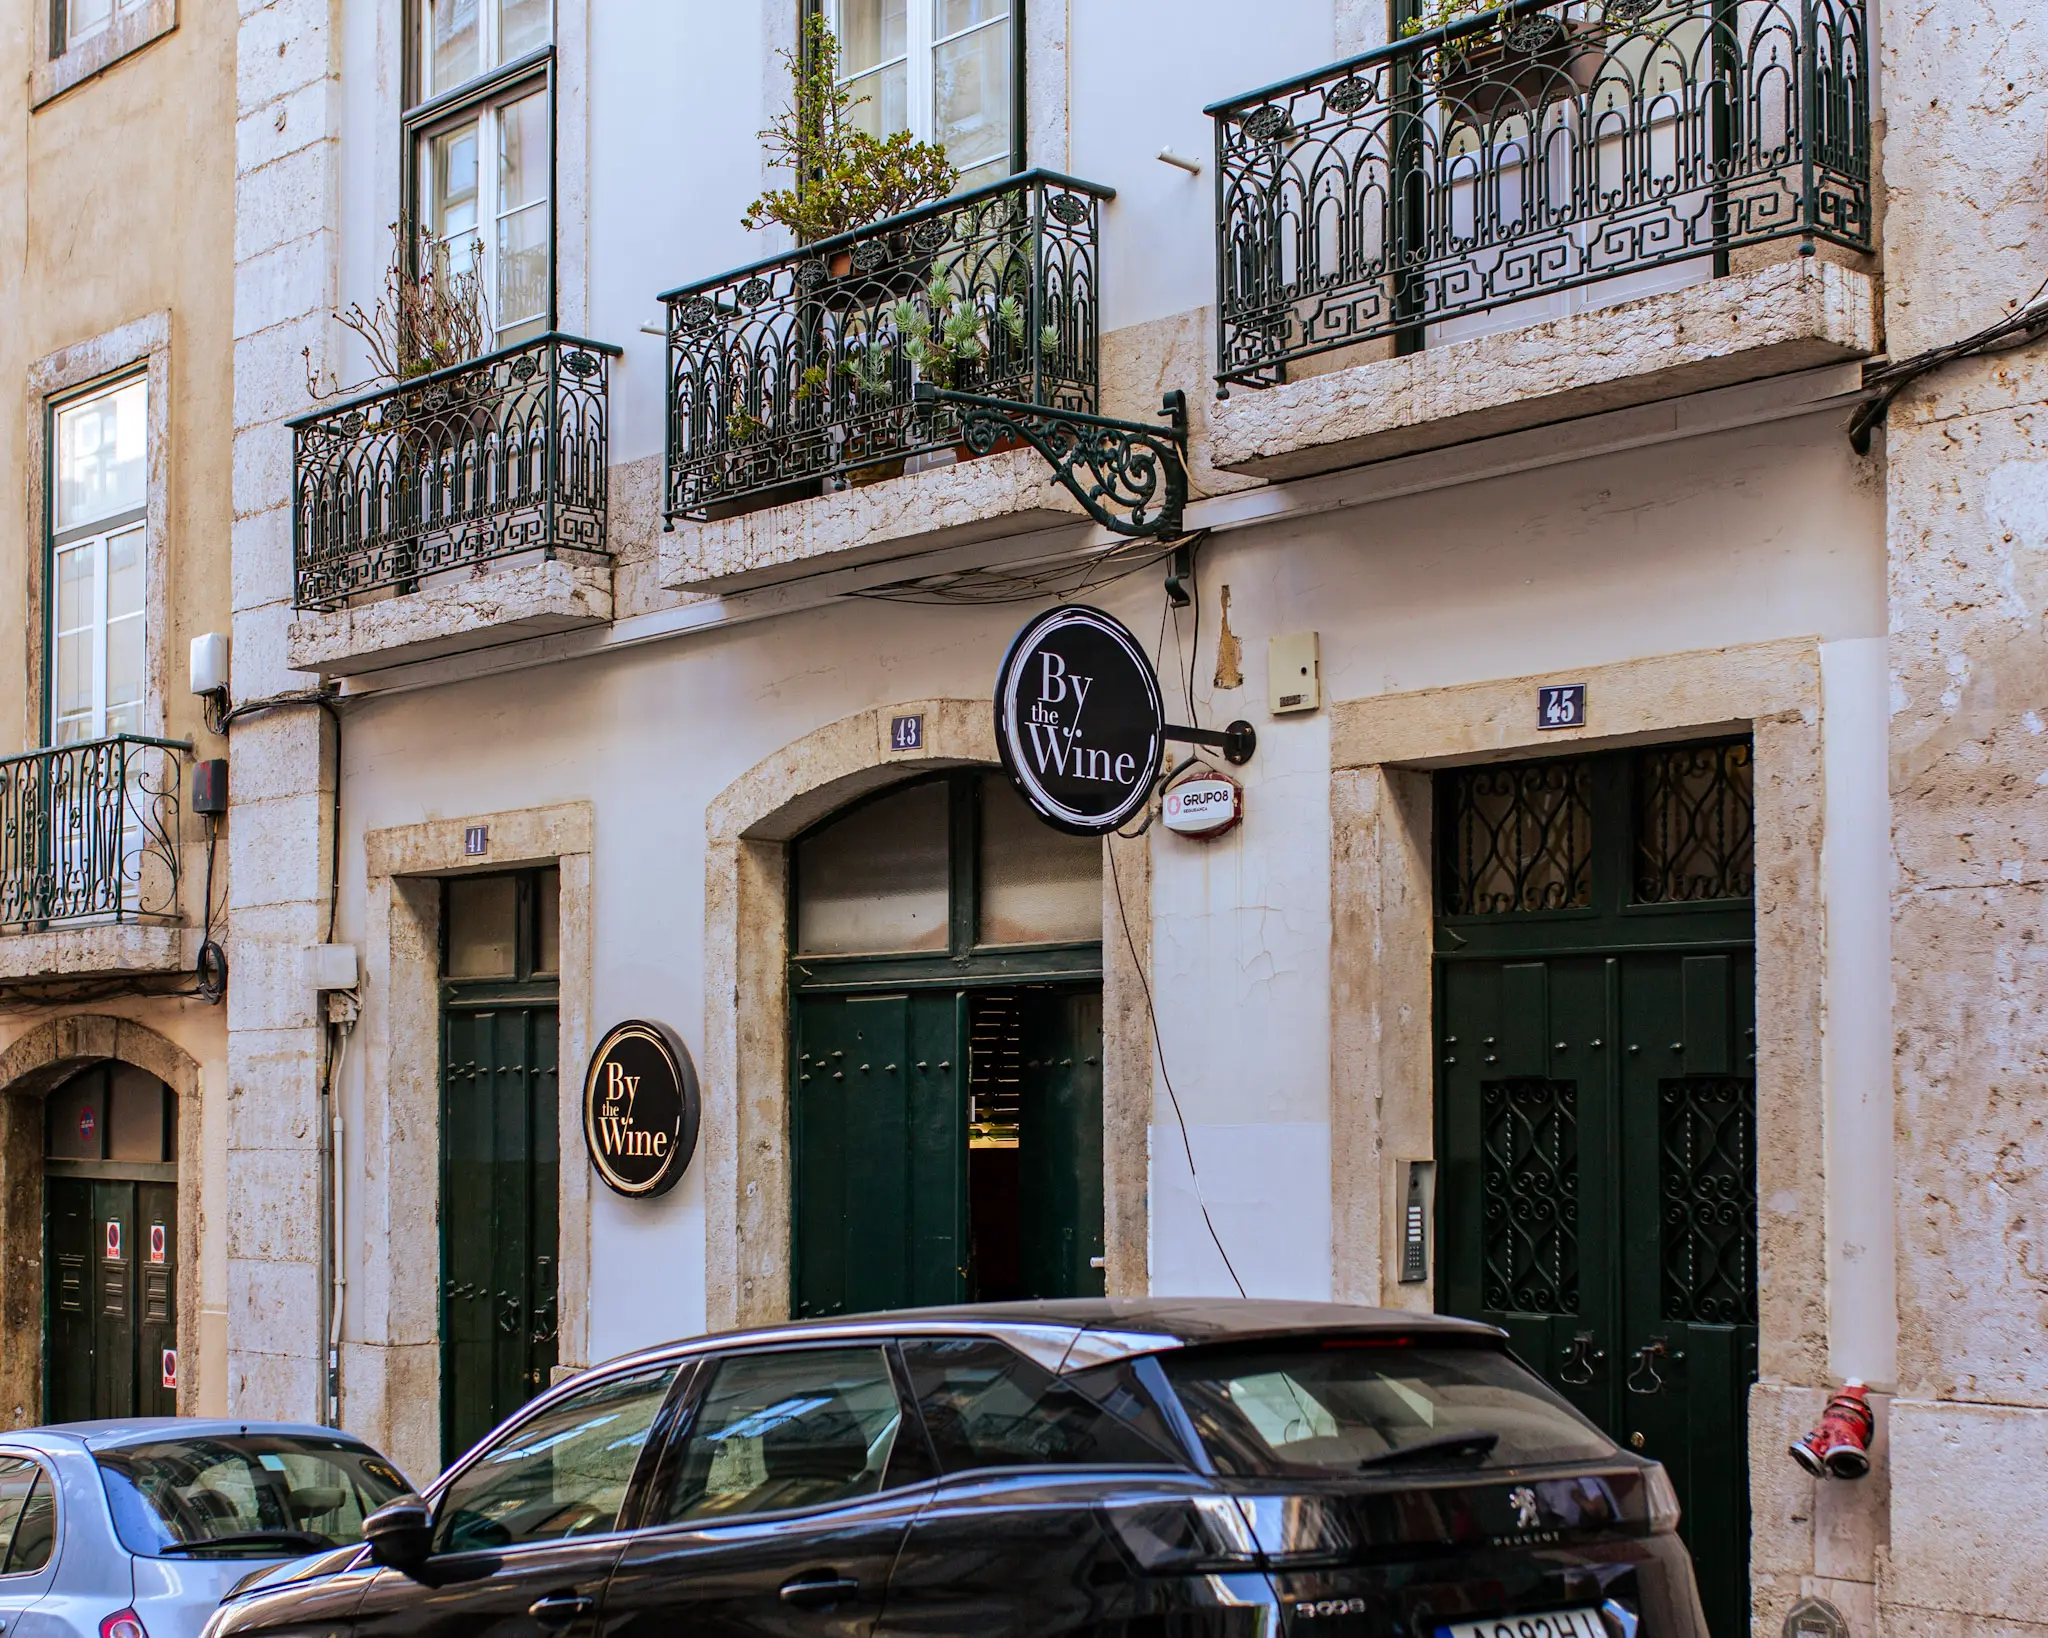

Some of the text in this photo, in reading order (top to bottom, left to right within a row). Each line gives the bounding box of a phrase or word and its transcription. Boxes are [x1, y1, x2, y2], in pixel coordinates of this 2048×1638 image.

[1038, 651, 1094, 738] By
[1546, 689, 1575, 724] 45
[1031, 702, 1059, 725] the
[896, 718, 917, 746] 43
[1024, 721, 1136, 785] Wine
[1183, 790, 1229, 806] GRUPO8
[468, 829, 482, 853] 41
[605, 1062, 641, 1125] By
[602, 1101, 620, 1118] the
[598, 1116, 668, 1158] Wine
